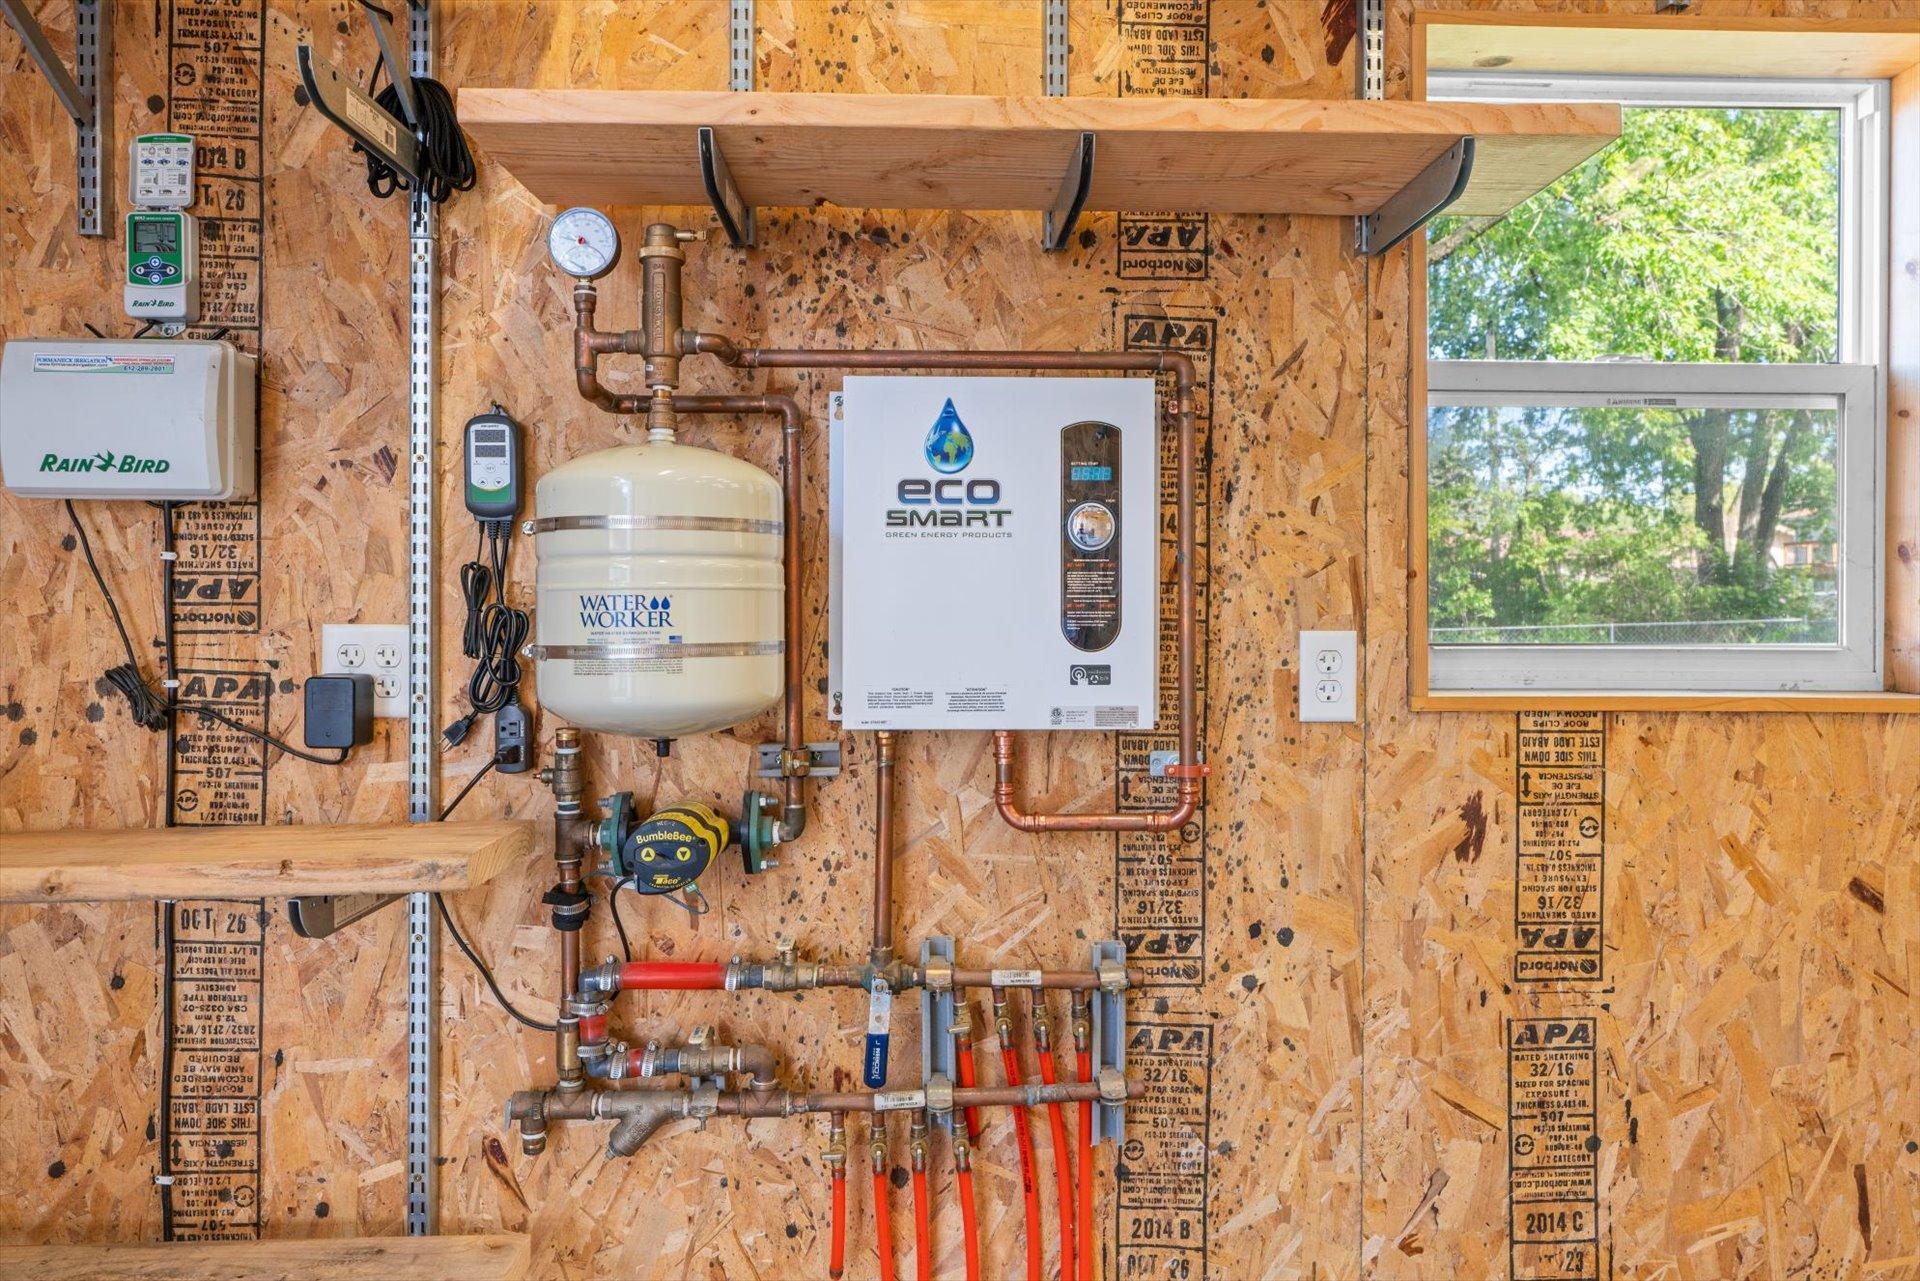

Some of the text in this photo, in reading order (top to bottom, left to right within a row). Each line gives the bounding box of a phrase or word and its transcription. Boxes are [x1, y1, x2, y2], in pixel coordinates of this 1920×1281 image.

[1126, 1, 1203, 11] RECOMMENDED
[1134, 11, 1193, 21] ROOF CLIPS
[1156, 30, 1178, 41] LADO
[1182, 30, 1204, 41] ESTE
[203, 41, 229, 53] 507
[1157, 44, 1176, 55] SIDE
[1181, 45, 1200, 56] THIS
[1140, 67, 1196, 76] RESISTENCIA
[1154, 77, 1166, 86] DE
[1123, 226, 1202, 247] APA
[1122, 260, 1184, 271] Norbord
[1131, 321, 1208, 346] APA
[40, 453, 171, 473] RAIN BIRD
[189, 545, 237, 559] 32/16
[173, 579, 253, 600] APA
[579, 594, 649, 611] WATER
[172, 612, 235, 626] Norbord
[579, 611, 674, 628] WORKER
[182, 676, 260, 700] APA
[1532, 720, 1590, 728] ROOF CLIPS
[1522, 736, 1601, 748] ESTE LADO ABAJO
[1124, 754, 1150, 766] DOWN
[1524, 751, 1597, 762] THIS SIDE DOWN
[206, 767, 232, 779] 507
[1151, 786, 1164, 794] DE
[1551, 782, 1581, 790] EJE DE
[1533, 792, 1600, 800] STRENGTH AXIS
[1522, 808, 1561, 817] CATEGORY
[636, 830, 693, 845] BumbleBee
[1549, 849, 1572, 861] 507
[1522, 885, 1556, 893] SPACING
[1558, 885, 1573, 893] FOR
[1137, 901, 1183, 915] 32/16
[1537, 896, 1582, 910] 32/16
[1571, 911, 1597, 919] RATED
[181, 908, 247, 934] OCT 26
[1120, 933, 1199, 954] APA
[1520, 928, 1597, 949] APA
[1145, 966, 1182, 979] Norb
[1519, 961, 1579, 974] Norbord
[195, 984, 237, 992] ADHESIVE
[183, 994, 205, 1002] TYPE
[227, 1005, 248, 1013] CSA
[1128, 1028, 1205, 1051] APA
[1514, 1023, 1591, 1045] APA
[188, 1055, 240, 1063] REQUIRED
[1544, 1053, 1590, 1061] SHEATHING
[183, 1065, 196, 1073] BE
[1530, 1062, 1575, 1077] 32/16
[174, 1075, 254, 1083] RECOMMENDED
[1143, 1067, 1189, 1083] 32/16
[182, 1085, 213, 1093] CLIPS
[1539, 1080, 1554, 1088] FOR
[1556, 1079, 1590, 1087] SPACING
[1525, 1090, 1570, 1098] EXPOSURE
[205, 1103, 229, 1114] LADO
[233, 1103, 256, 1114] ESTE
[1540, 1110, 1565, 1122] 507
[205, 1118, 227, 1129] SIDE
[230, 1117, 251, 1129] THIS
[1152, 1118, 1176, 1129] 507
[201, 1220, 226, 1231] 507
[1526, 1210, 1584, 1235] 2014 C
[1131, 1218, 1191, 1240] 2014 B
[1169, 1258, 1190, 1280] 26
